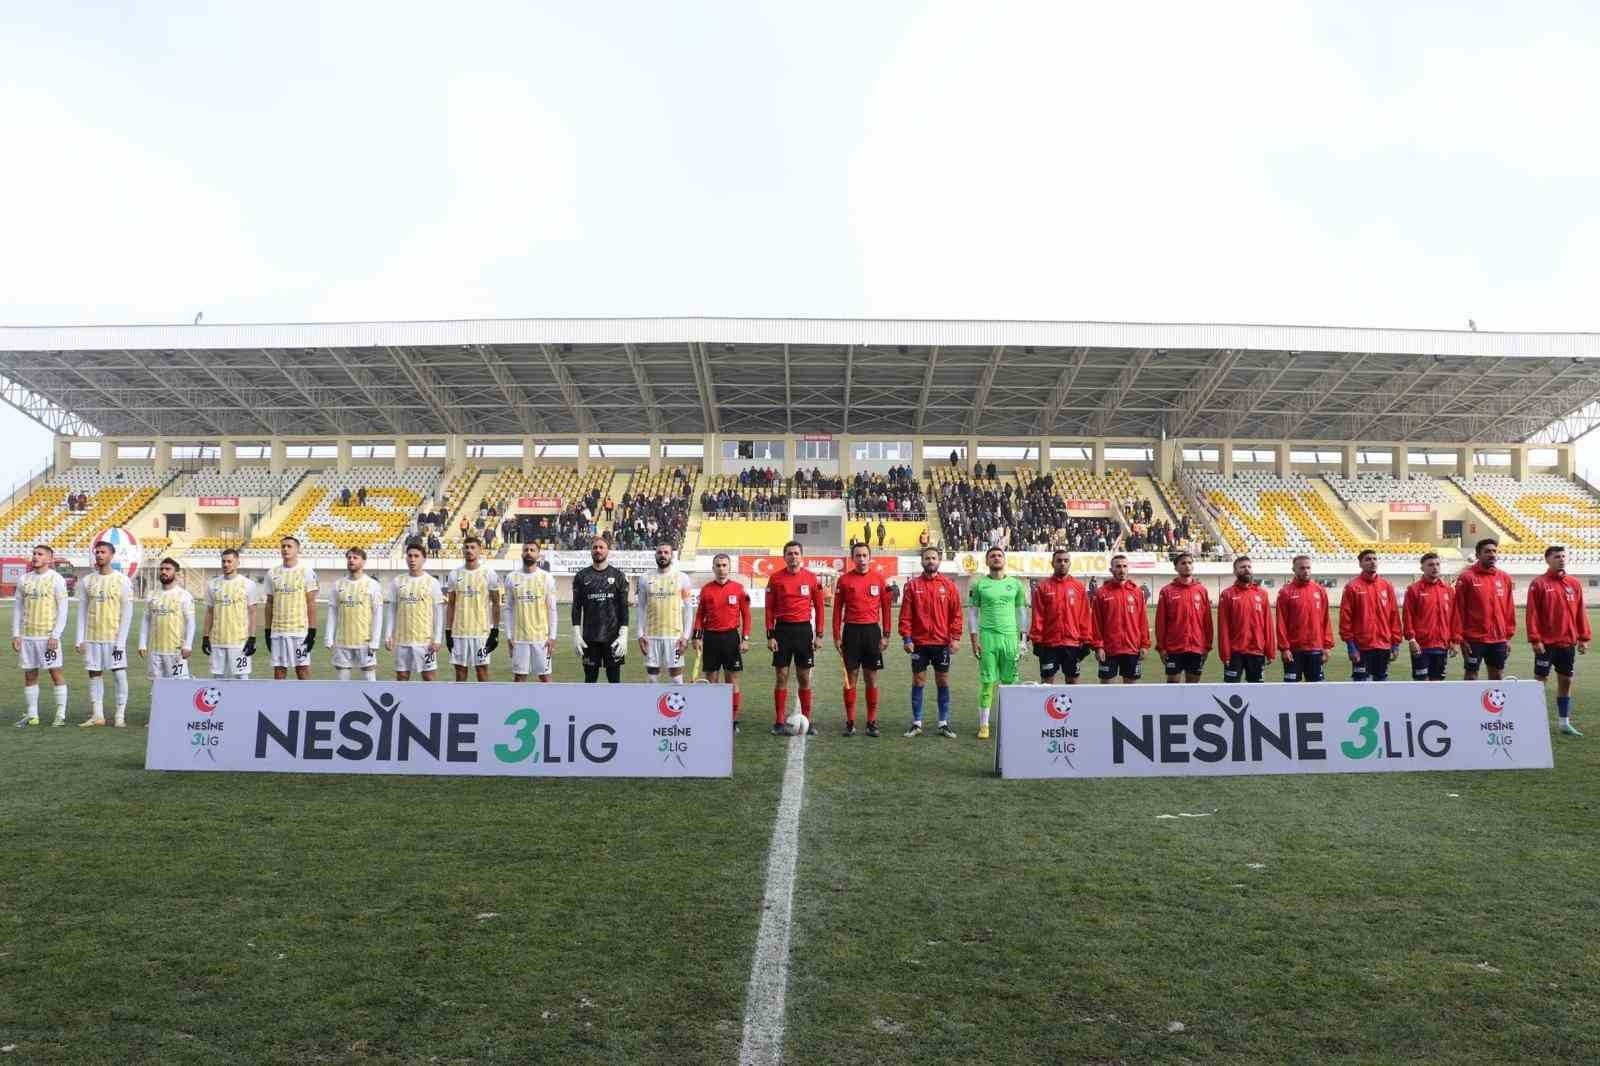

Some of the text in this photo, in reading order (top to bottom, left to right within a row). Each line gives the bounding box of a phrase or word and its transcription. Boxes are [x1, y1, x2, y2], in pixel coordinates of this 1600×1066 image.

[44, 651, 57, 661] 99
[236, 657, 248, 668] 28
[172, 664, 183, 676] 27
